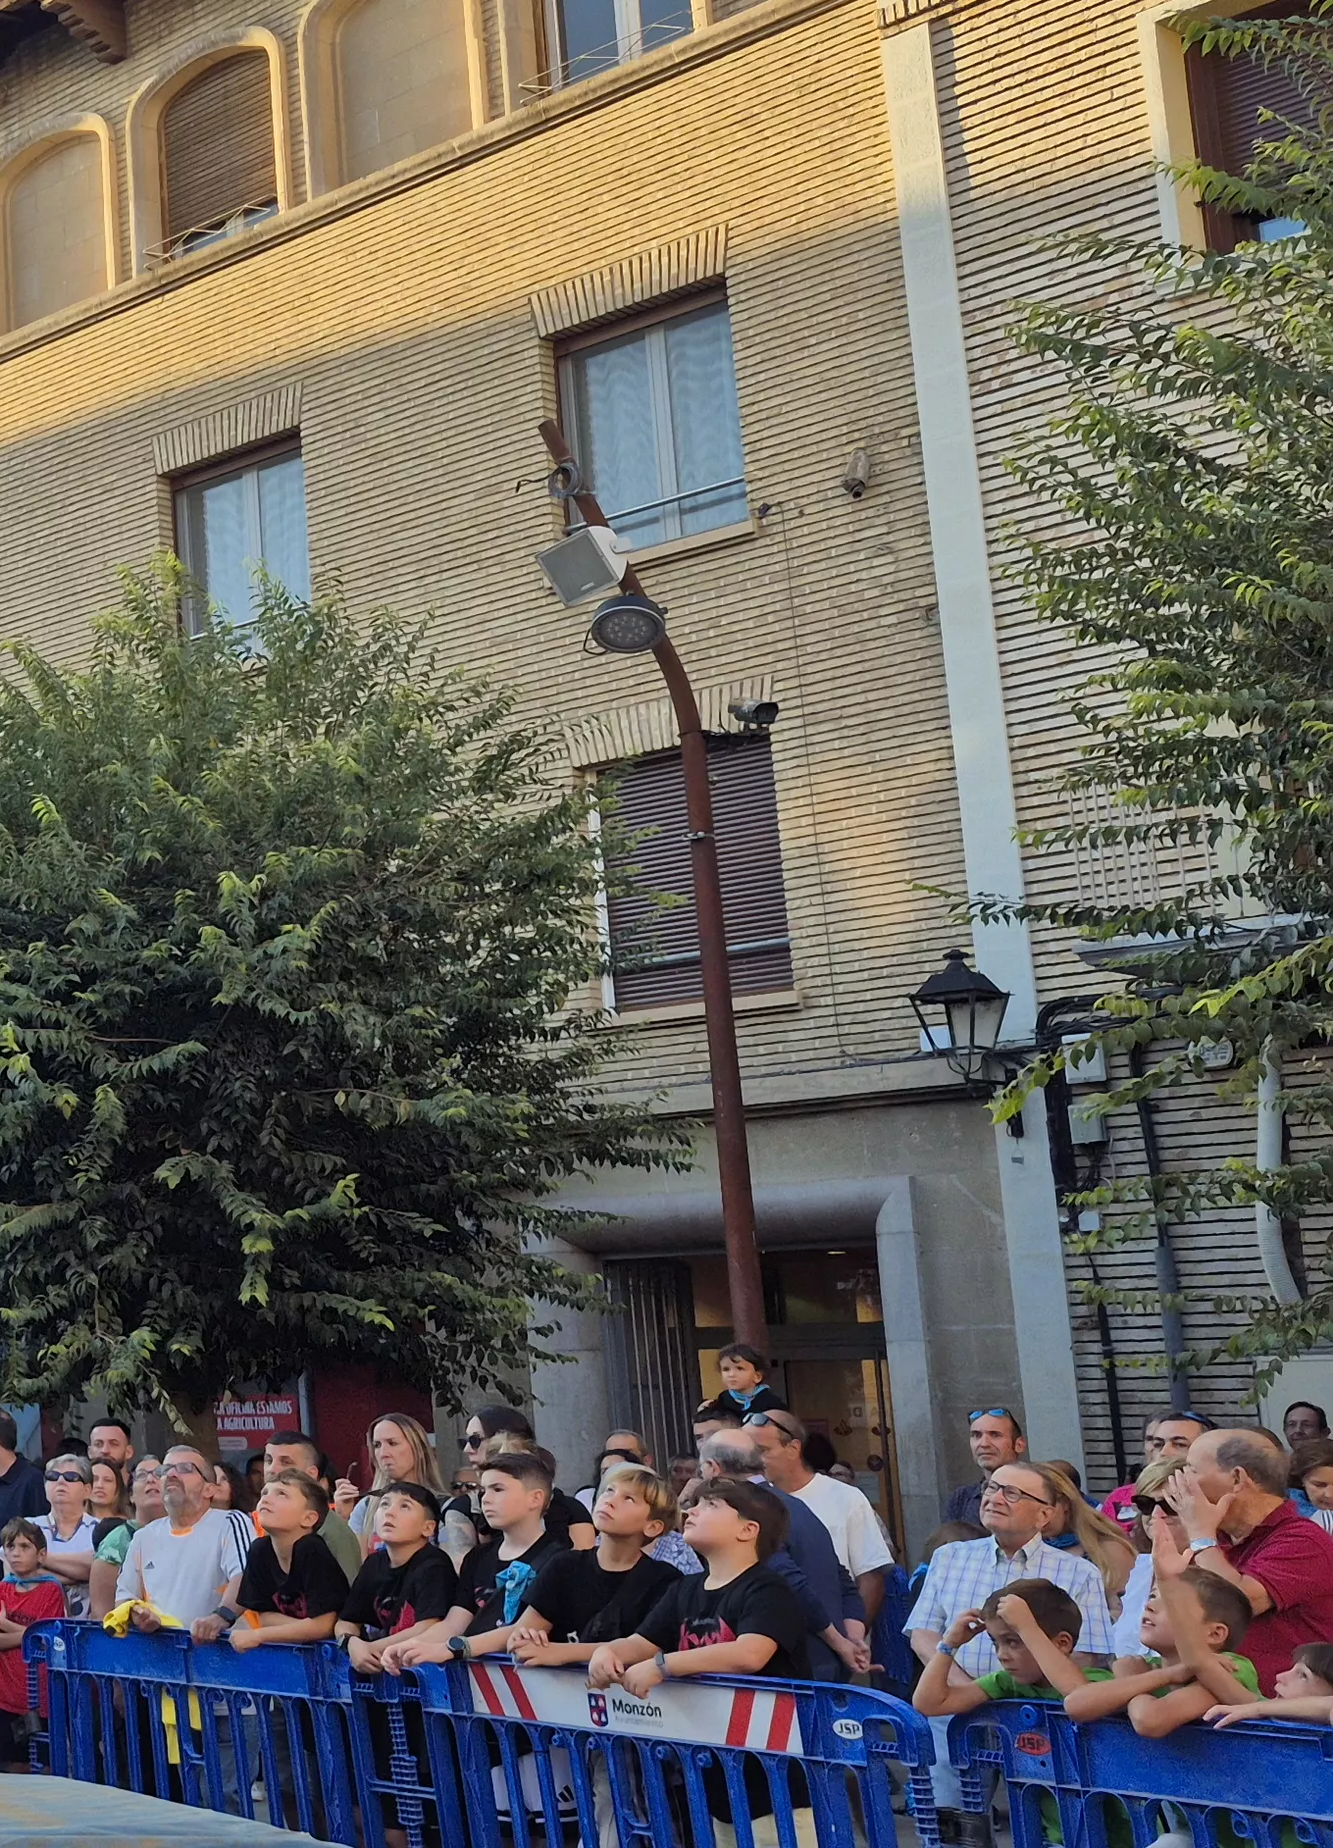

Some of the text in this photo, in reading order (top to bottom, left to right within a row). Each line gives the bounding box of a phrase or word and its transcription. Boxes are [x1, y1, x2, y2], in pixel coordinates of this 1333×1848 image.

[224, 1416, 275, 1430] AGRICULTURA
[611, 1699, 662, 1718] Monzón
[838, 1722, 860, 1735] JSP
